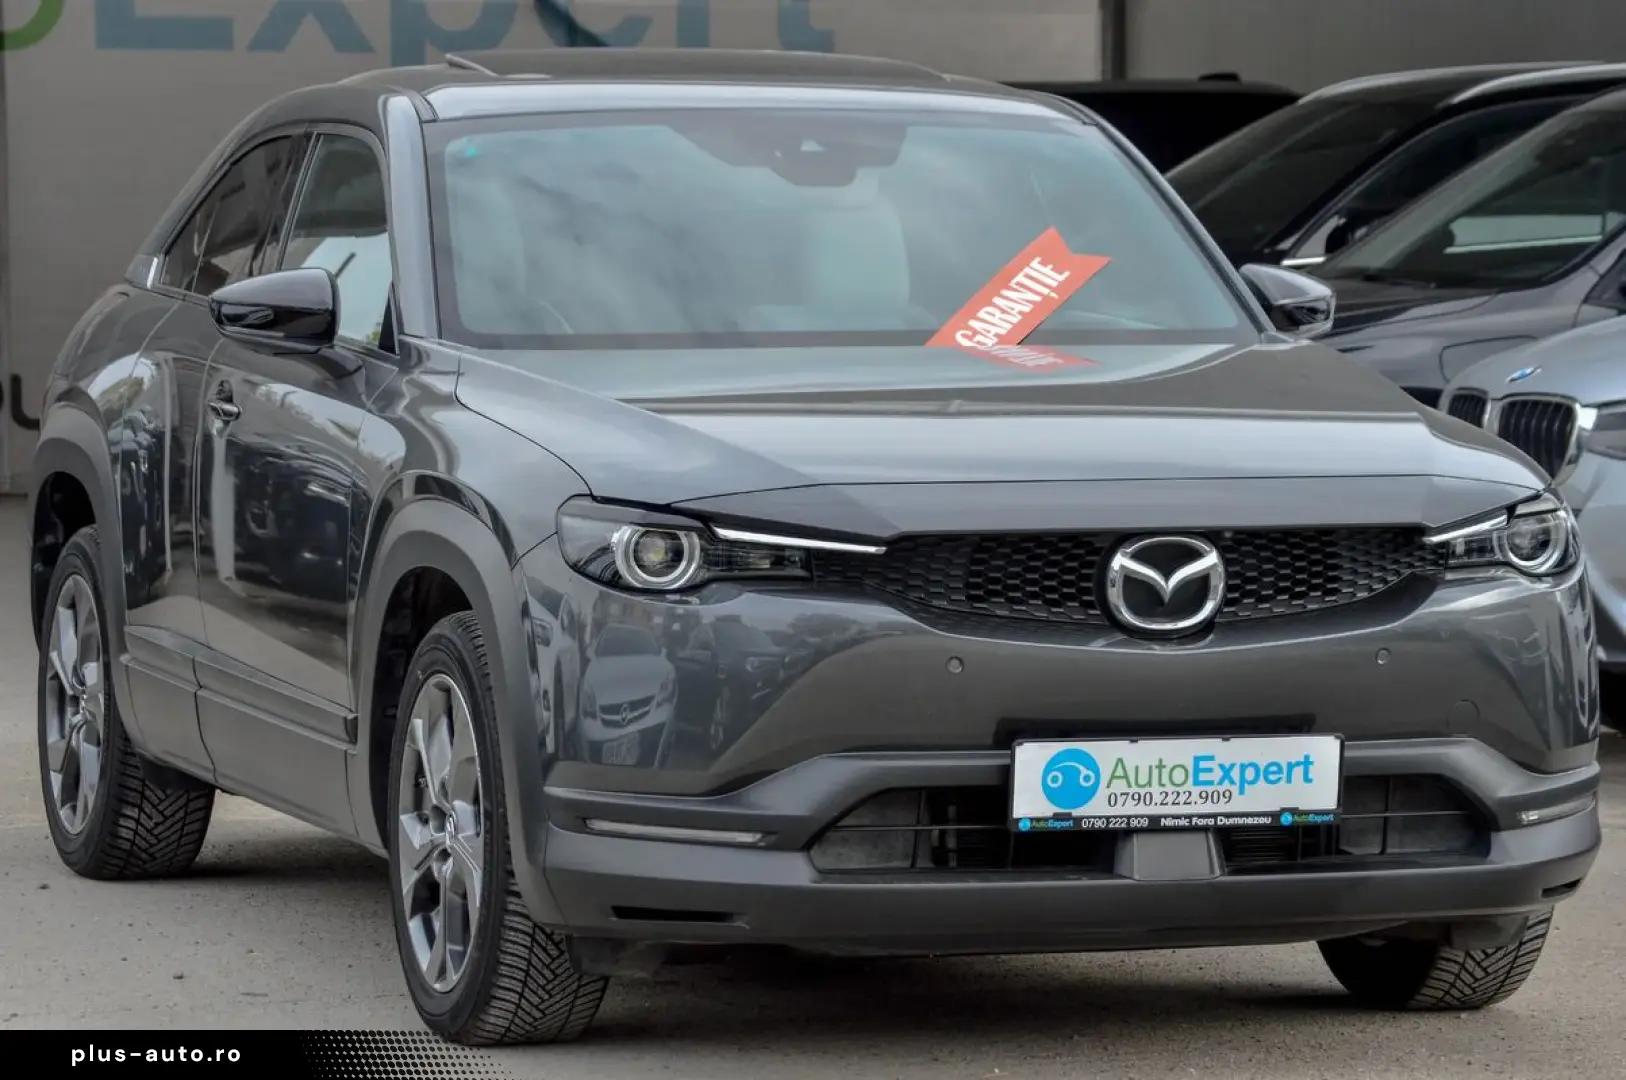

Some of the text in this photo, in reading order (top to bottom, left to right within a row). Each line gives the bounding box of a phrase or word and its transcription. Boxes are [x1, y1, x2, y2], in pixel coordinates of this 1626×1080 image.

[1106, 754, 1314, 795] AutoExpert
[1107, 789, 1233, 808] 0790.222.909
[1030, 819, 1073, 829] AutoExpert
[1081, 817, 1148, 829] 0790 222 909
[1161, 816, 1272, 827] Nimic Fara Dumnezeu
[1292, 814, 1334, 823] AutoExpert
